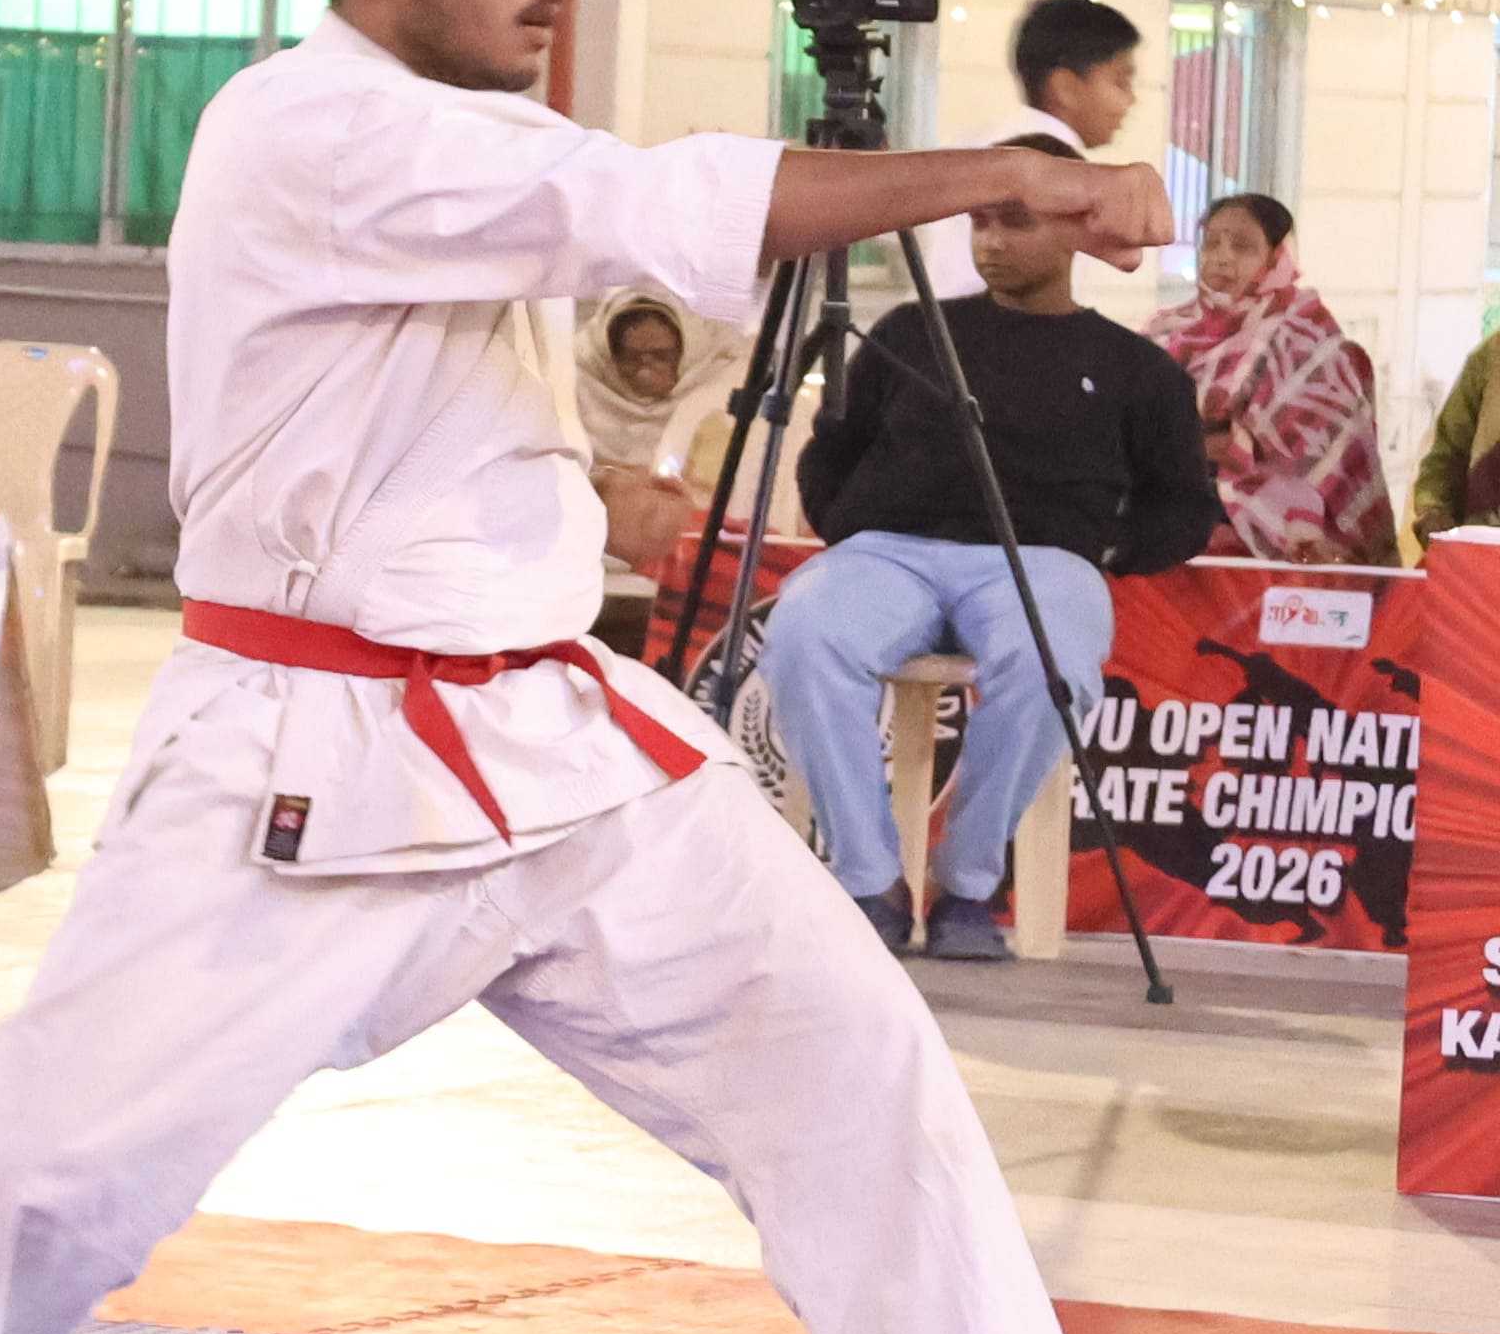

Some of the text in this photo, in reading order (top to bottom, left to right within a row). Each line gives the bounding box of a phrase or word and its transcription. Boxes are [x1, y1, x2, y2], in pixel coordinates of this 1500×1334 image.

[1150, 699, 1292, 761] OPEN
[1306, 708, 1420, 770] NATI
[1202, 772, 1417, 841] CHIMPIO
[1206, 842, 1343, 905] 2026
